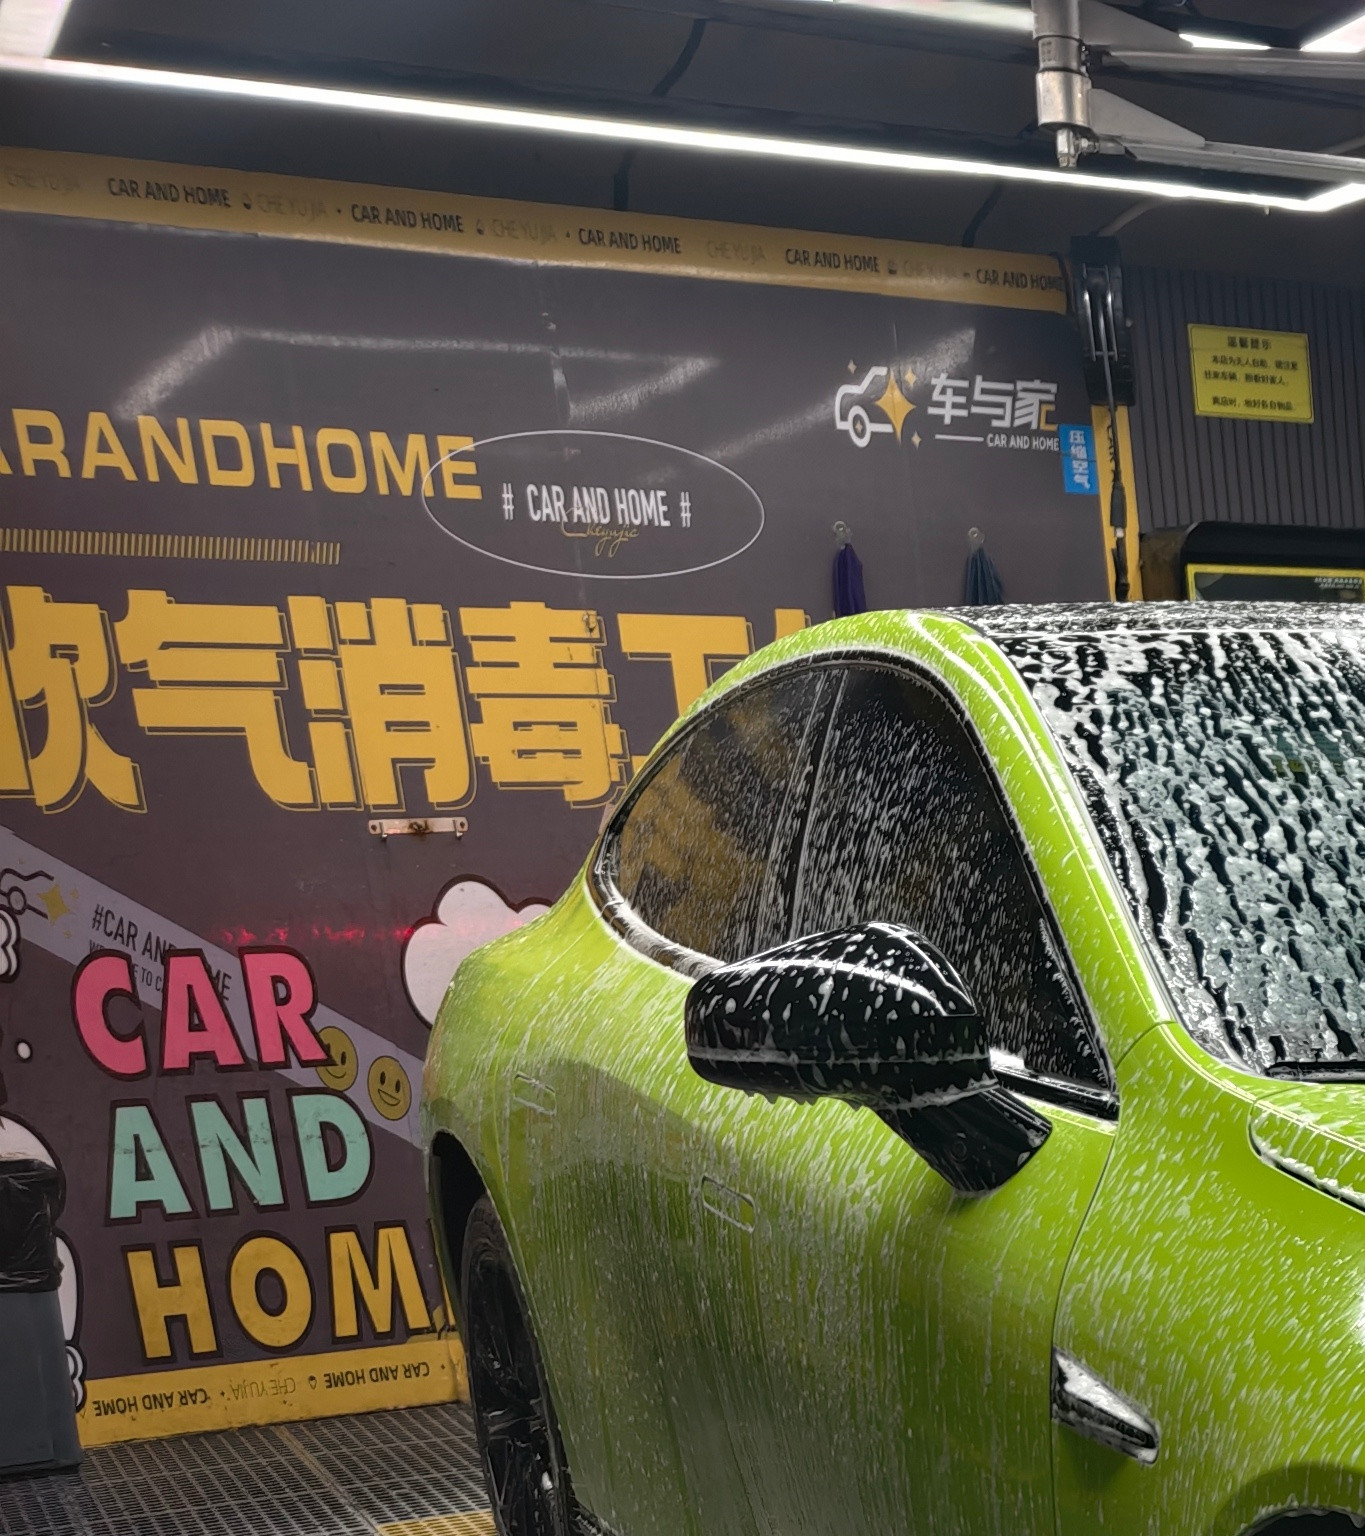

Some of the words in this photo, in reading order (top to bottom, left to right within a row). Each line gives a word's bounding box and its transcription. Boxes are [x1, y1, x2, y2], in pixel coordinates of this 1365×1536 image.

[108, 178, 141, 198] CAR
[145, 182, 180, 203] AND
[183, 187, 231, 208] HOME
[352, 204, 381, 224] CAR
[385, 208, 417, 227] AND
[421, 212, 464, 232] HOME
[578, 228, 605, 245] CAR
[609, 231, 638, 249] AND
[642, 235, 681, 254] HOME
[785, 248, 809, 266] CAR
[813, 250, 841, 269] AND
[844, 253, 880, 272] HOME
[975, 268, 999, 285] CAR
[1002, 271, 1028, 288] AND
[1030, 273, 1063, 292] HOME
[927, 372, 1058, 432] 车与家
[0, 407, 483, 500] RANDHOME
[986, 433, 1007, 448] CAR
[1009, 434, 1030, 450] AND
[1032, 437, 1060, 451] HOME
[1069, 429, 1091, 490] 压缩空气
[502, 483, 514, 520] #
[527, 484, 568, 522] CAR
[573, 486, 610, 525] AND
[614, 488, 671, 527] HOME
[680, 492, 691, 528] #
[0, 585, 806, 812] 吹气消毒工
[92, 903, 138, 951] #CAR
[142, 931, 176, 966] AN
[74, 950, 335, 1077] CAR
[109, 1094, 373, 1219] AND
[127, 1226, 432, 1360] HOM
[324, 1371, 366, 1389] HOME
[368, 1367, 399, 1384] AND
[404, 1361, 430, 1379] CAR
[95, 1397, 139, 1417] HOME
[143, 1392, 173, 1410] AND
[179, 1387, 209, 1405] CAR
